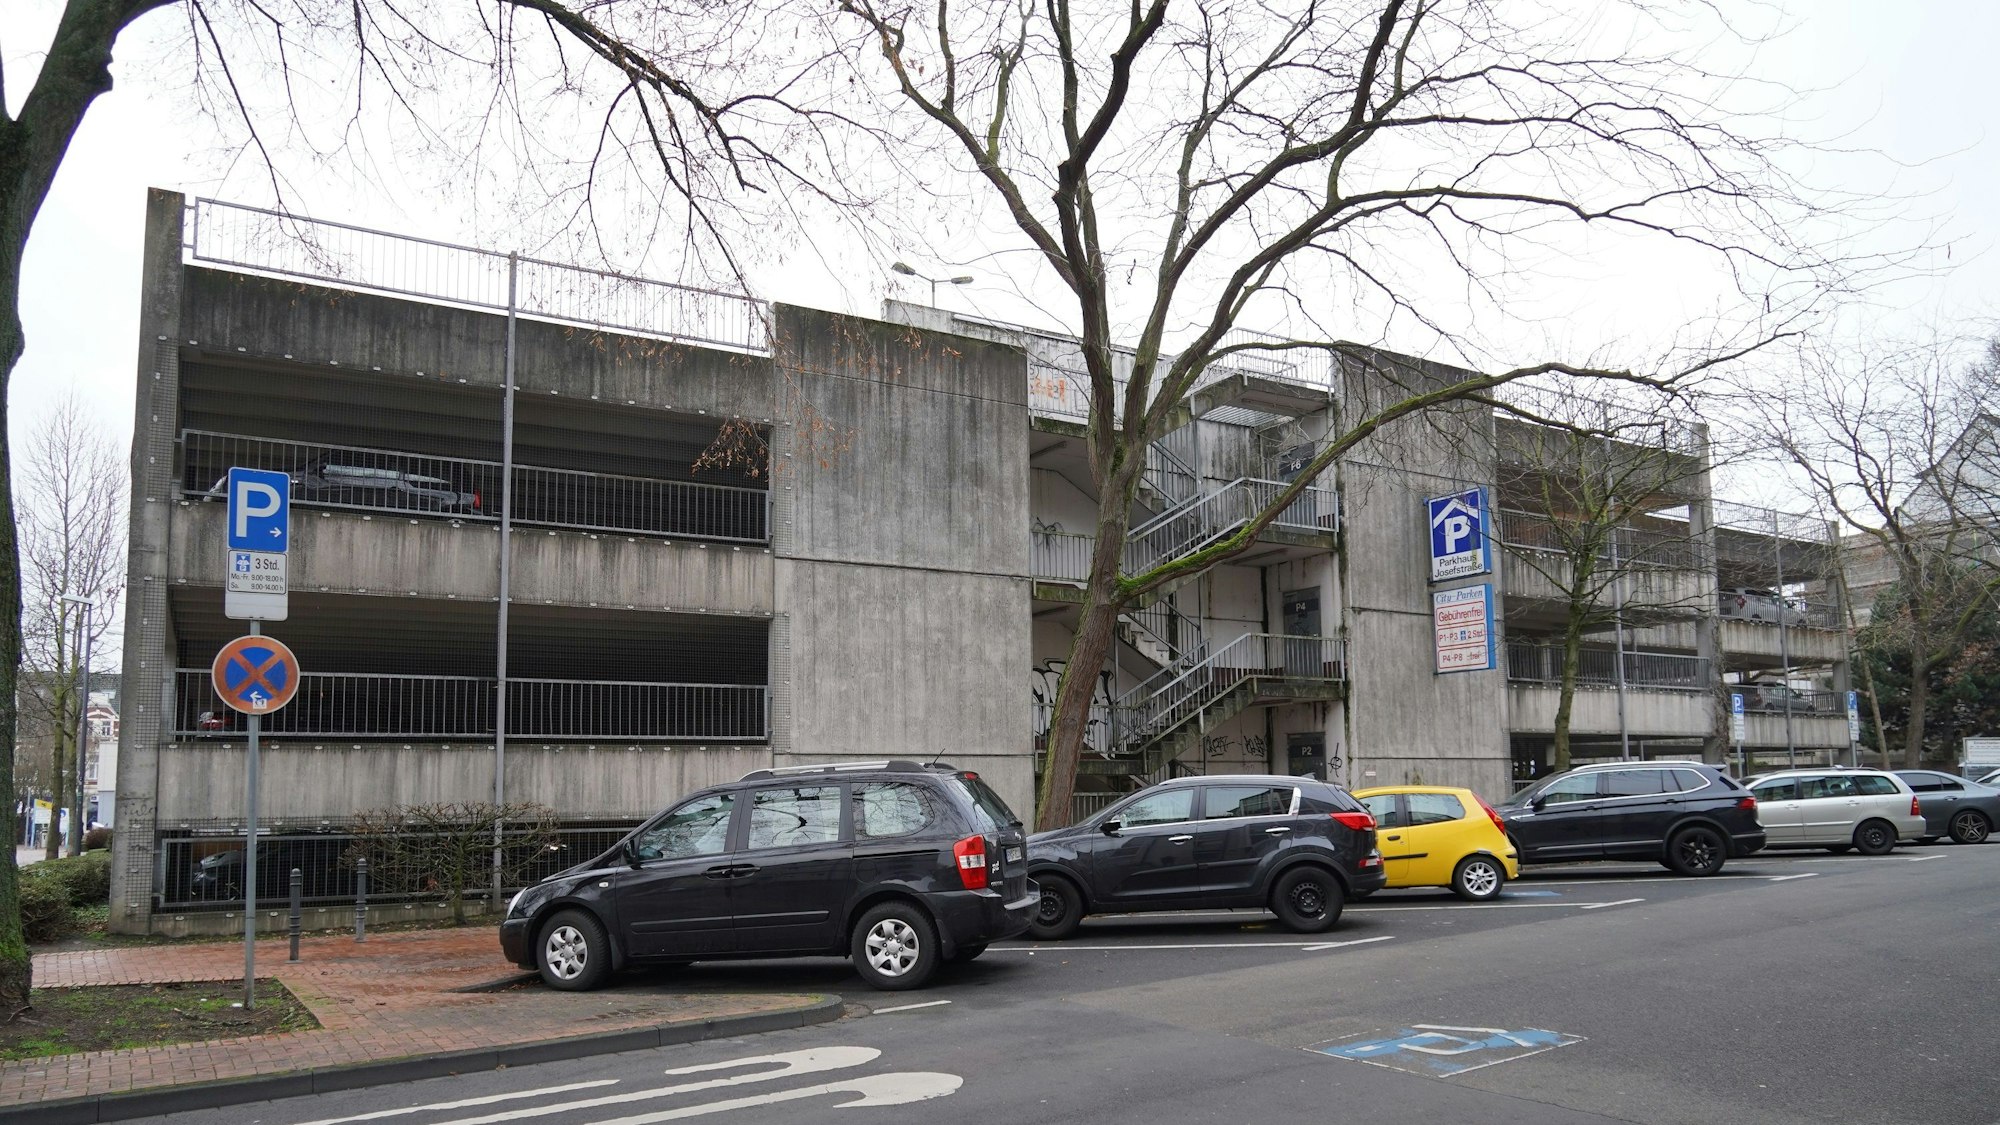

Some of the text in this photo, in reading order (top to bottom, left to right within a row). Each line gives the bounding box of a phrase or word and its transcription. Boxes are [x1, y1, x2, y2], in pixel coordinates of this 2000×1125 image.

[236, 480, 281, 538] P
[1444, 515, 1471, 554] P
[255, 557, 280, 571] 3 Std.
[1439, 554, 1477, 567] Parkhaus
[1434, 562, 1483, 577] Josefstraße
[1295, 602, 1306, 612] P4
[1438, 605, 1483, 622] Gebührenfrei
[1467, 630, 1472, 640] 2
[1301, 746, 1313, 756] P2
